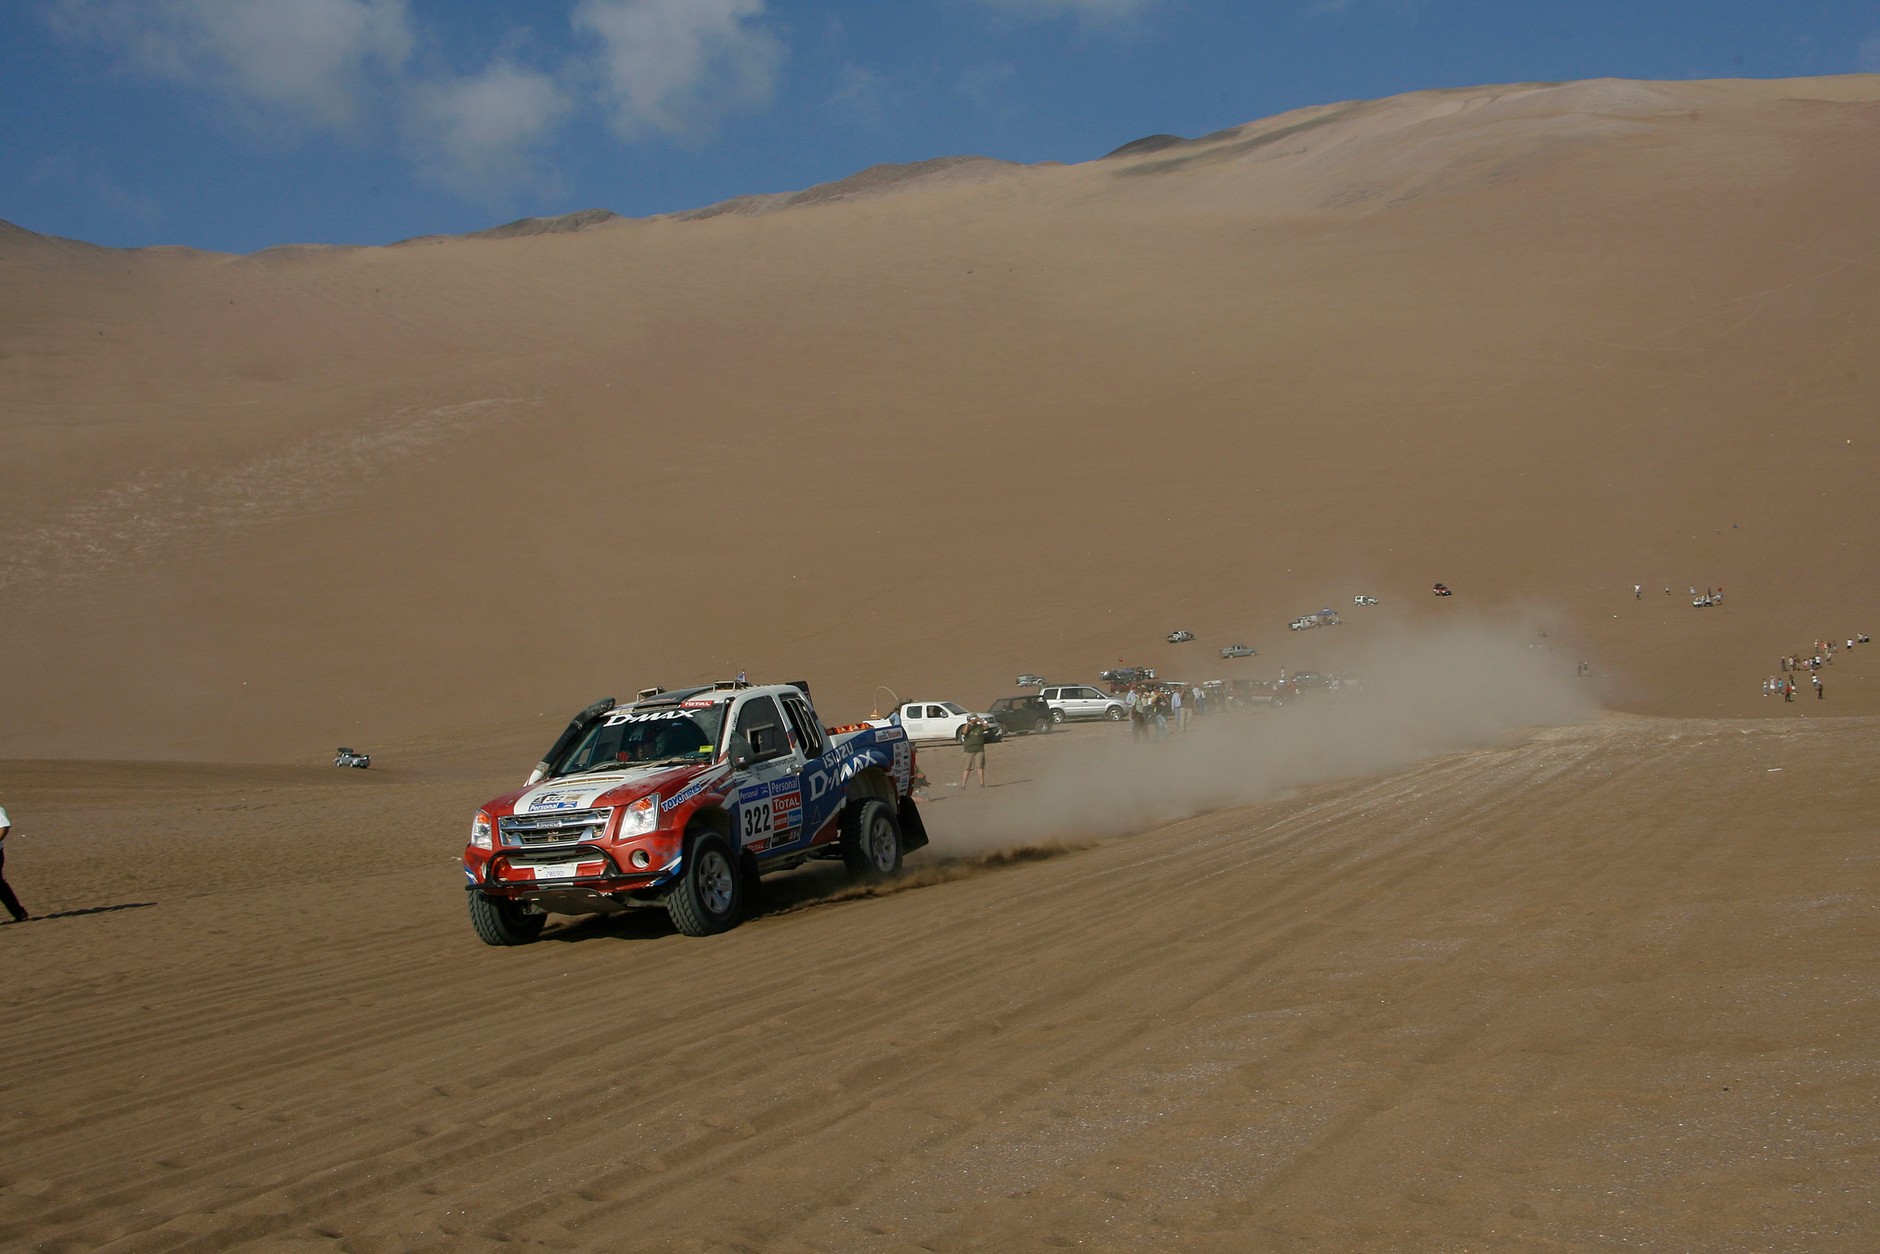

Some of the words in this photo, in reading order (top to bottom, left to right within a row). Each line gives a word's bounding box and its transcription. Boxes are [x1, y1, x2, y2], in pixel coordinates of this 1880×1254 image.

[822, 741, 854, 769] ISUZU
[740, 787, 759, 800] Personal
[771, 780, 798, 793] Personal
[662, 794, 684, 811] TOYO
[683, 783, 702, 799] TIRES
[773, 796, 800, 811] TOTAL
[530, 803, 559, 811] Personal
[745, 804, 771, 837] 322
